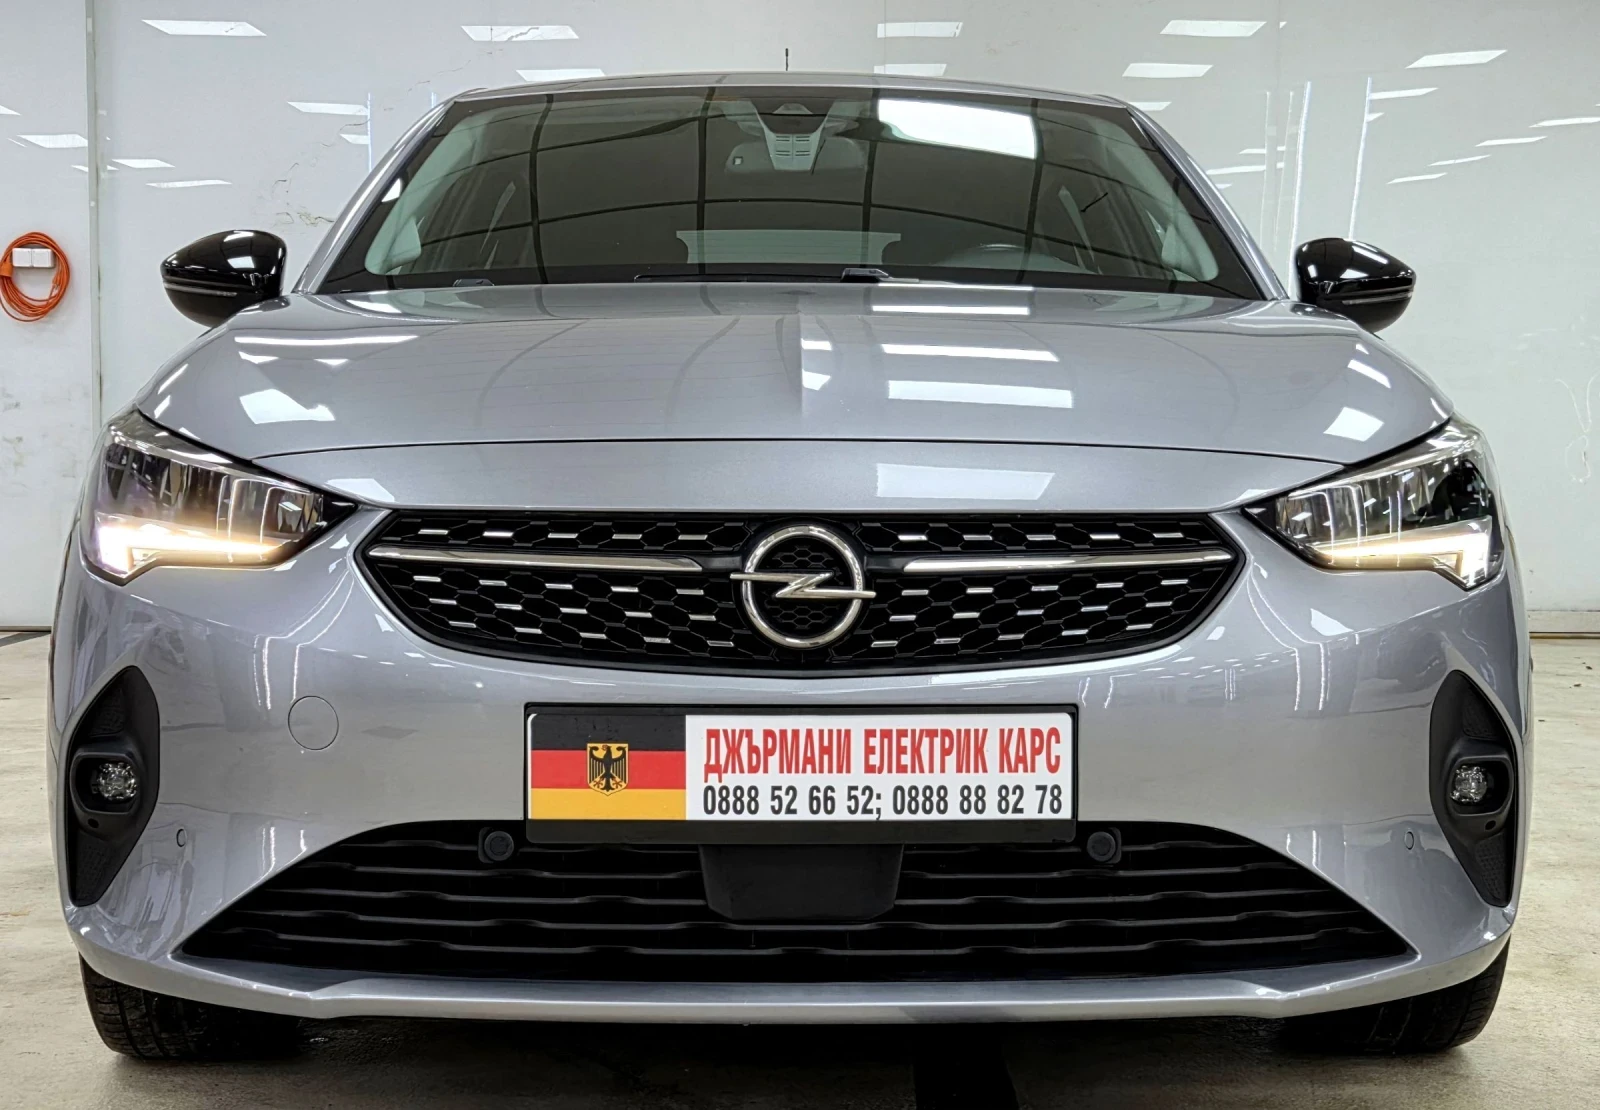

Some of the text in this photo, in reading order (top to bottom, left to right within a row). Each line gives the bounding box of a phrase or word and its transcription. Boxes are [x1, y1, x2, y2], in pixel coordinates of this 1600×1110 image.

[704, 727, 1061, 783] ДЖЪРМАНИ ЕЛЕКТРИК КАРС
[703, 785, 1062, 820] 0888 52 66 52; 0888 88 82 78
